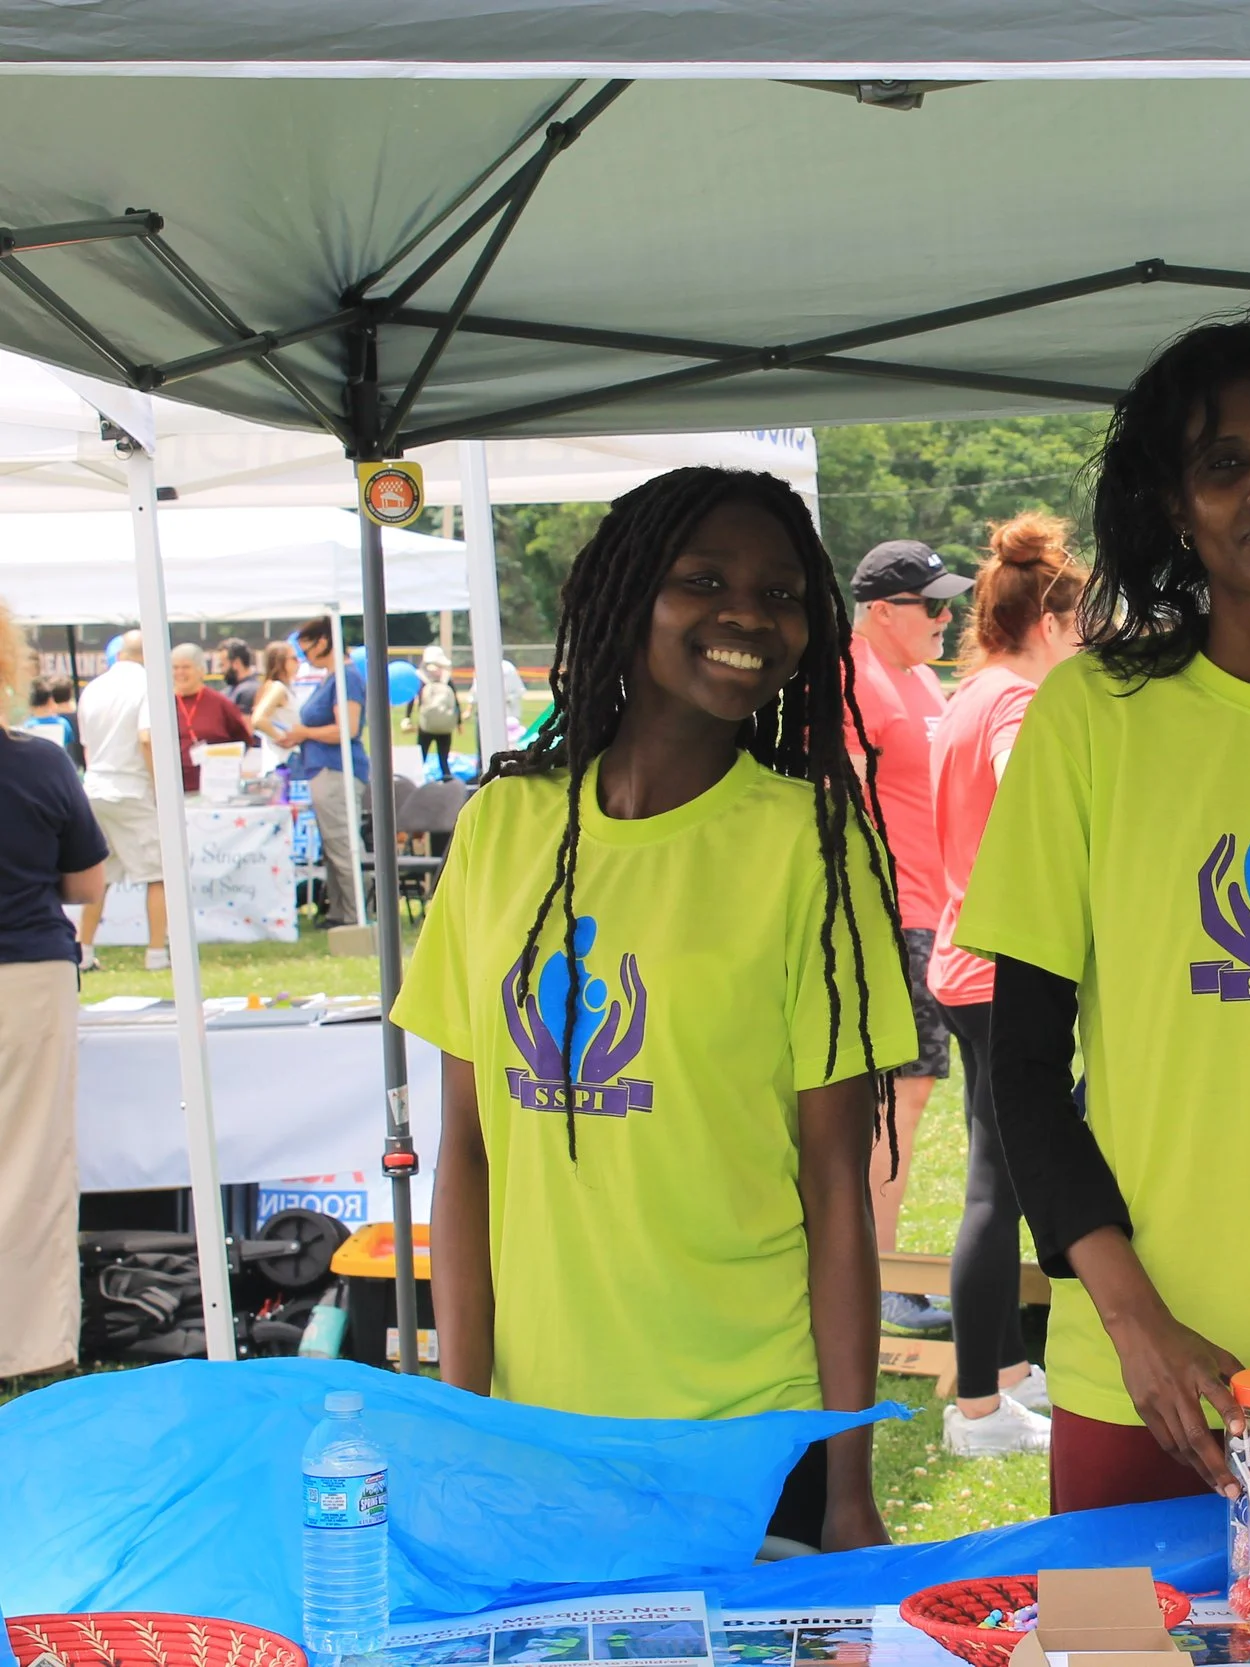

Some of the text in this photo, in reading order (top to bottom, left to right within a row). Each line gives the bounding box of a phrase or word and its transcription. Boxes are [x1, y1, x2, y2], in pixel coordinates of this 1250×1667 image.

[201, 842, 267, 869] Singers
[534, 1087, 605, 1110] SSPI
[388, 1626, 469, 1641] iapers
[502, 1608, 624, 1624] Mosquito
[632, 1605, 692, 1613] Nets
[570, 1613, 669, 1623] Uganda
